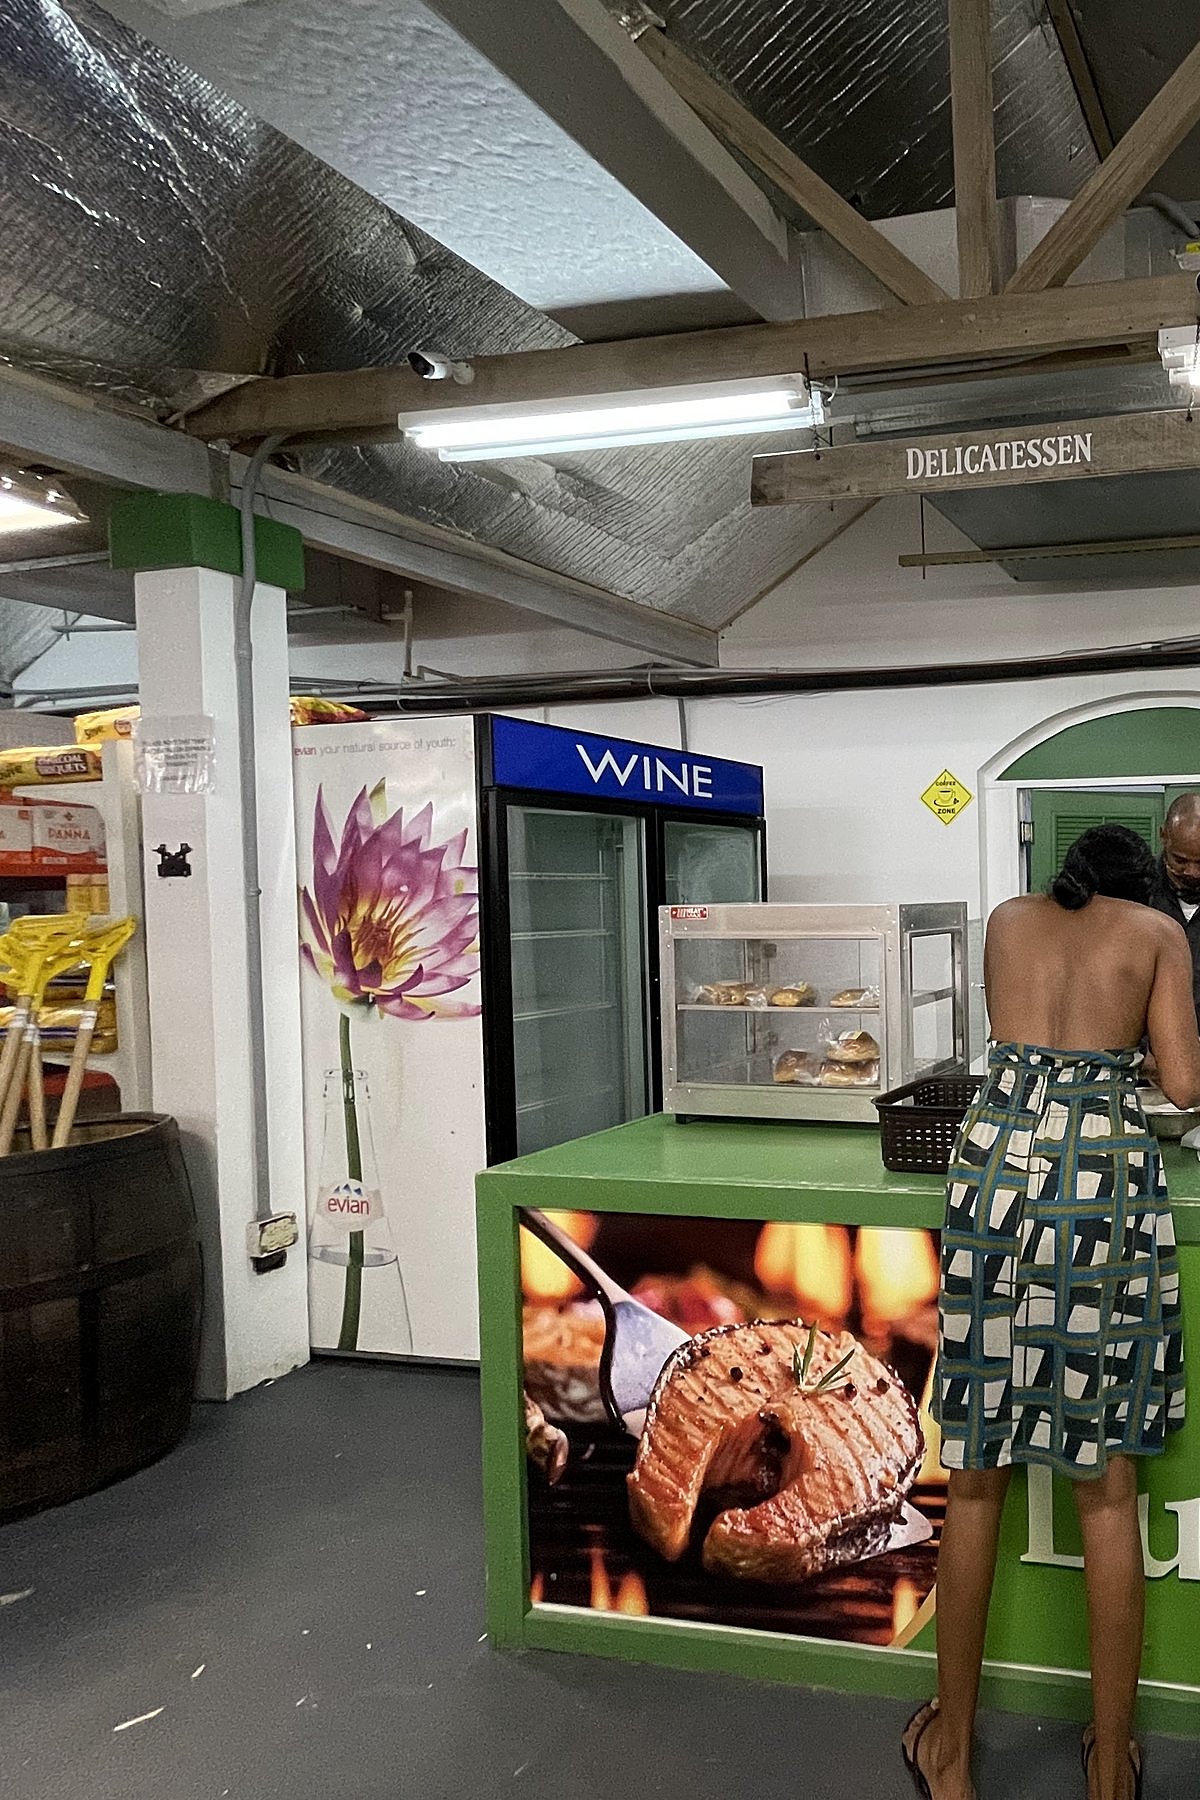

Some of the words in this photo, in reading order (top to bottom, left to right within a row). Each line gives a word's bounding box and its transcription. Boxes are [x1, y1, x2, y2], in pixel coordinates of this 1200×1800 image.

[906, 433, 1093, 480] DELICATESSEN
[294, 745, 317, 756] evian
[319, 745, 341, 757] your
[343, 742, 376, 754] natural
[378, 740, 412, 752] source
[414, 738, 423, 750] of
[576, 744, 713, 799] WINE
[48, 827, 91, 840] PANNA
[327, 1195, 370, 1215] evian
